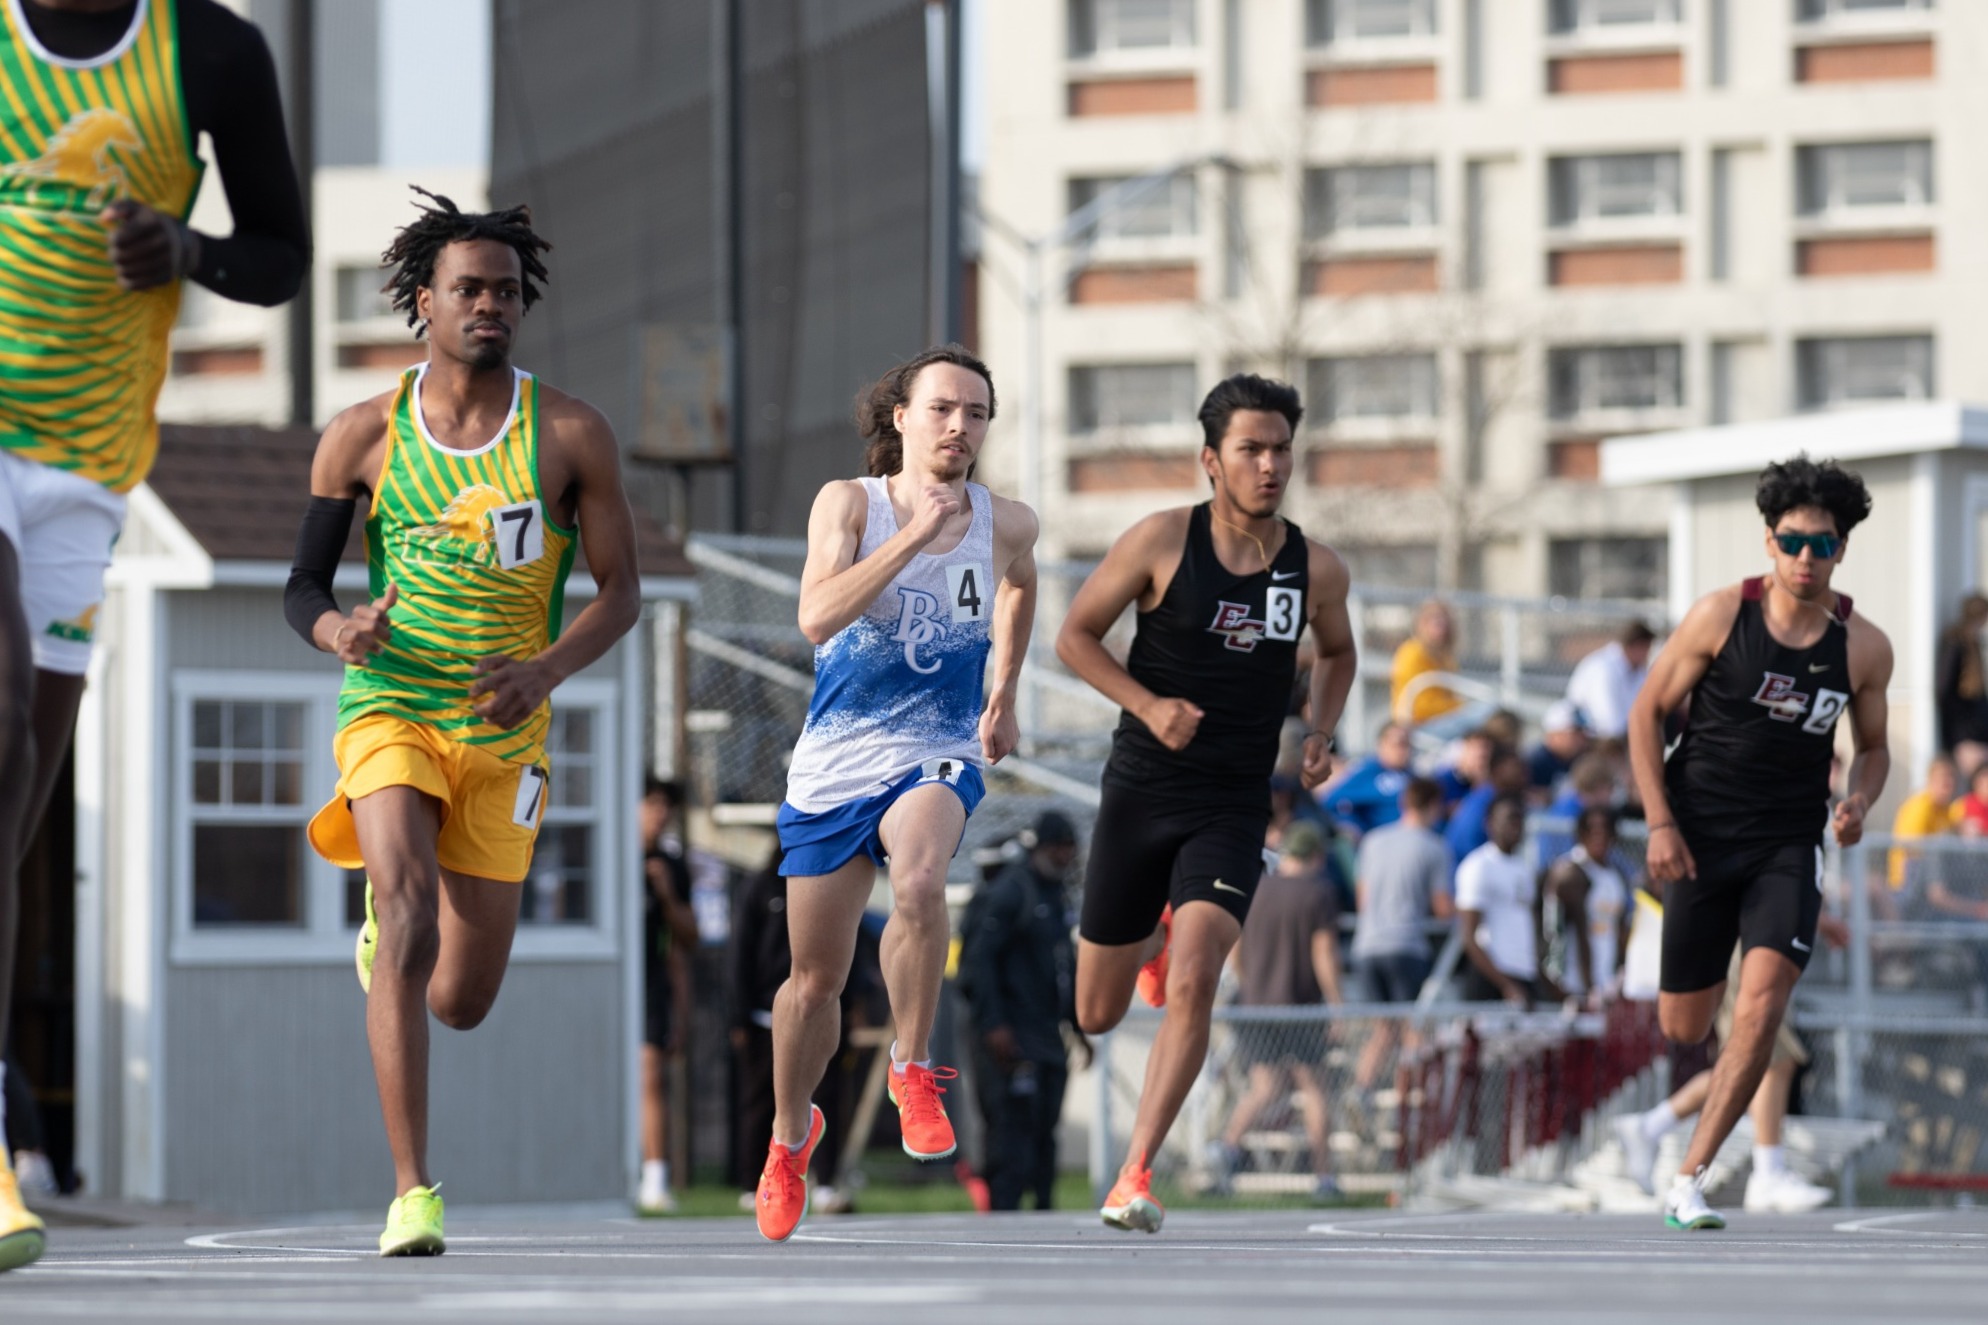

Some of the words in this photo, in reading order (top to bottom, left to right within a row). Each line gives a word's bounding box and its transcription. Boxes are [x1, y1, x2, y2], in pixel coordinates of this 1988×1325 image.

[501, 507, 533, 561] 7
[957, 569, 981, 616] 4
[1273, 592, 1293, 634] 3
[889, 587, 948, 675] BC
[1810, 697, 1840, 729] 2
